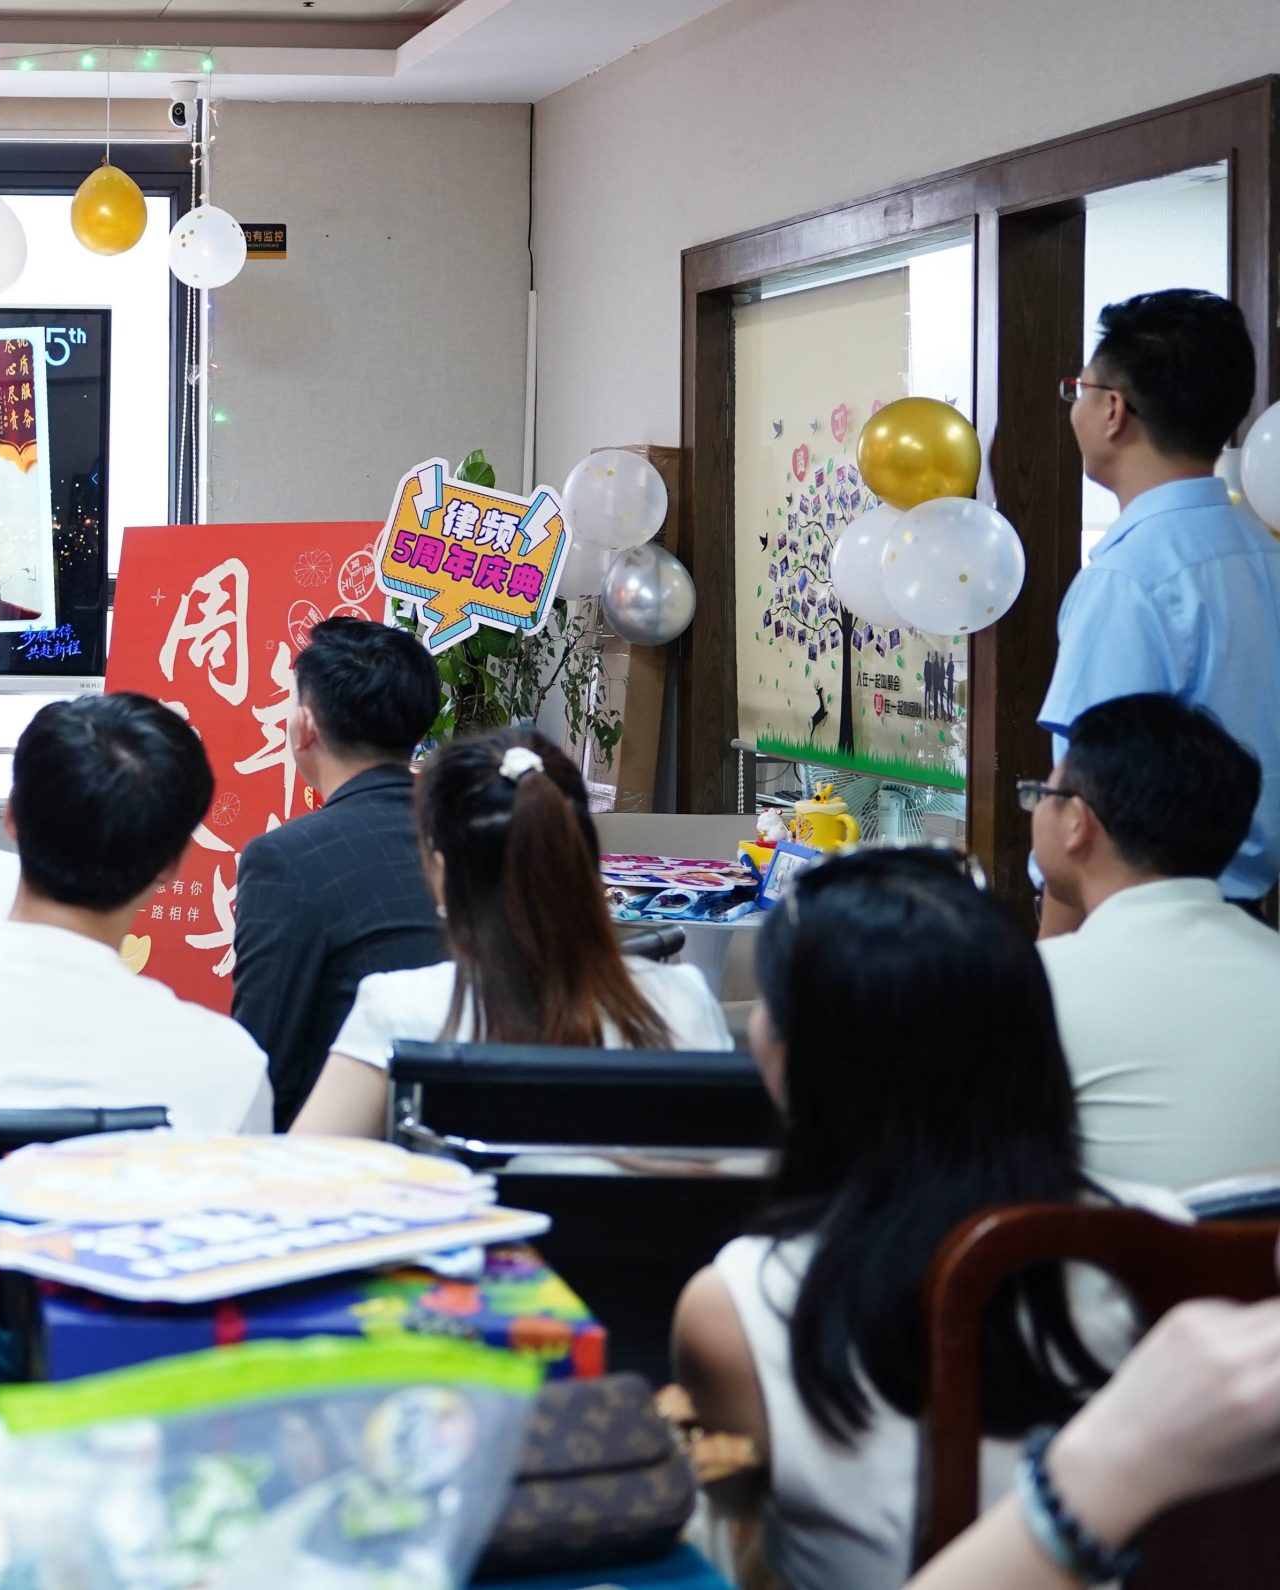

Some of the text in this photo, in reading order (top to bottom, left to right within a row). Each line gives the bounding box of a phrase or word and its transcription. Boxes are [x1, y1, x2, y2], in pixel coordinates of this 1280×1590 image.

[45, 327, 87, 366] 5th
[441, 498, 521, 554] 律频
[391, 530, 544, 603] 5周年庆典
